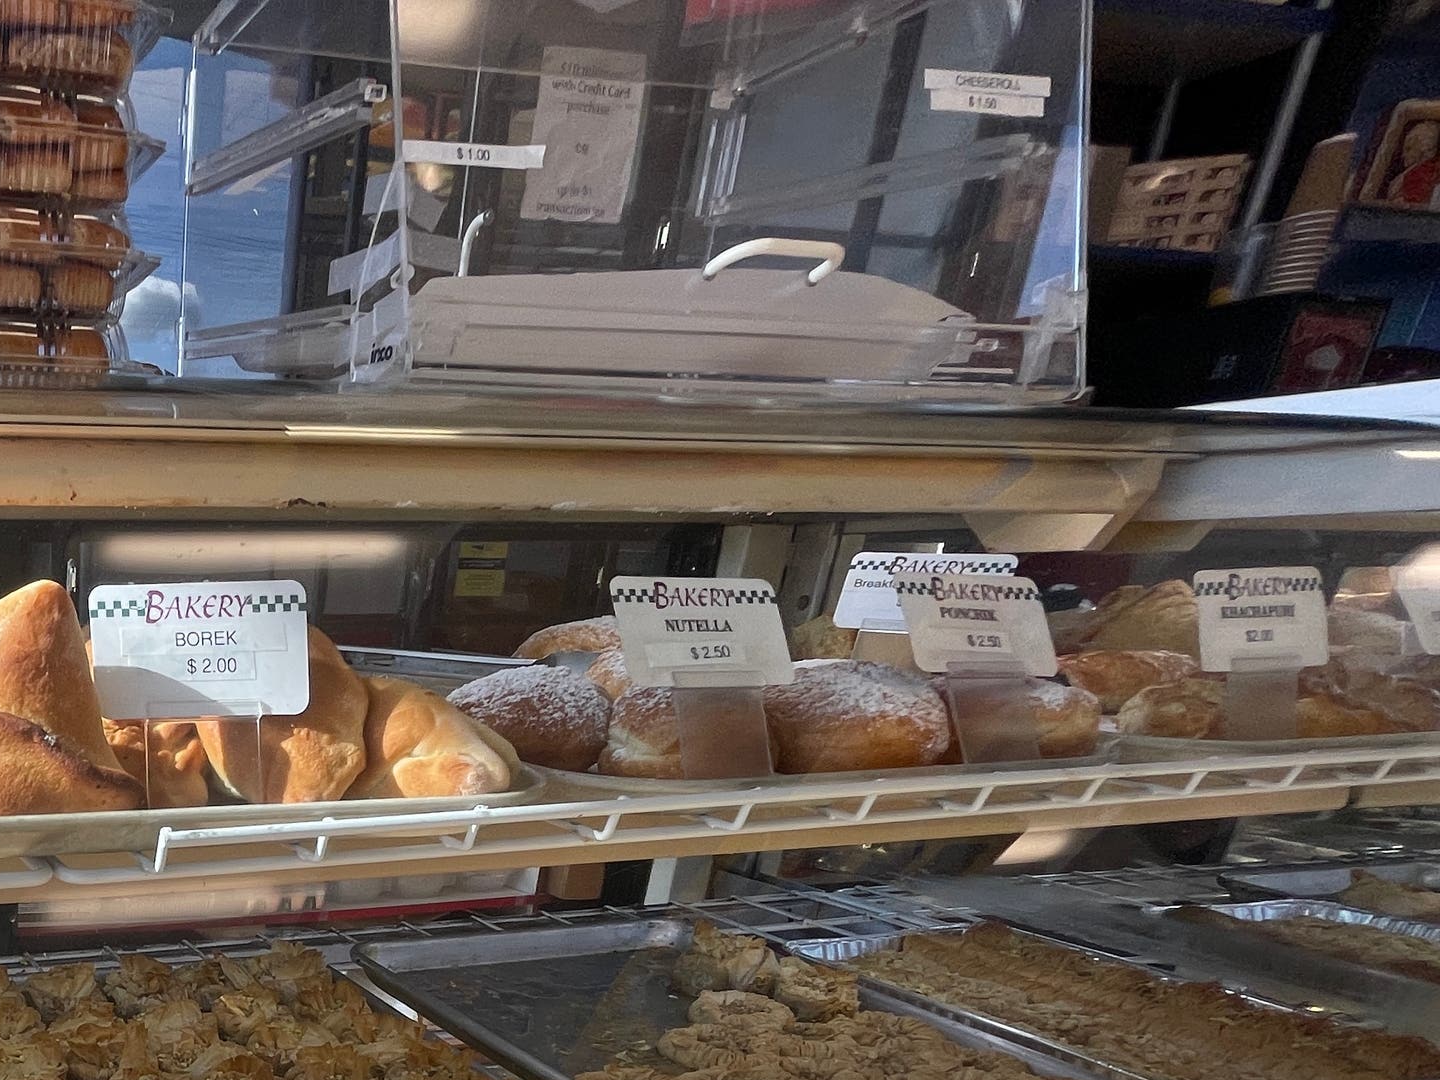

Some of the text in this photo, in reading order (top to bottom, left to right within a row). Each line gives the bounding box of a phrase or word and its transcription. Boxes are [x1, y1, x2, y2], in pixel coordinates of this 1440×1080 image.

[577, 80, 607, 97] Credit
[608, 85, 631, 99] Card
[888, 556, 974, 575] BAKERY
[854, 579, 895, 589] Breakf
[931, 577, 1003, 601] BAKERY
[1228, 574, 1291, 600] BAKERY
[653, 582, 734, 609] BAKERY
[146, 590, 252, 624] BAKERY
[665, 619, 733, 633] NUTELLA
[175, 631, 237, 647] BOREK
[203, 657, 237, 673] 2.00
